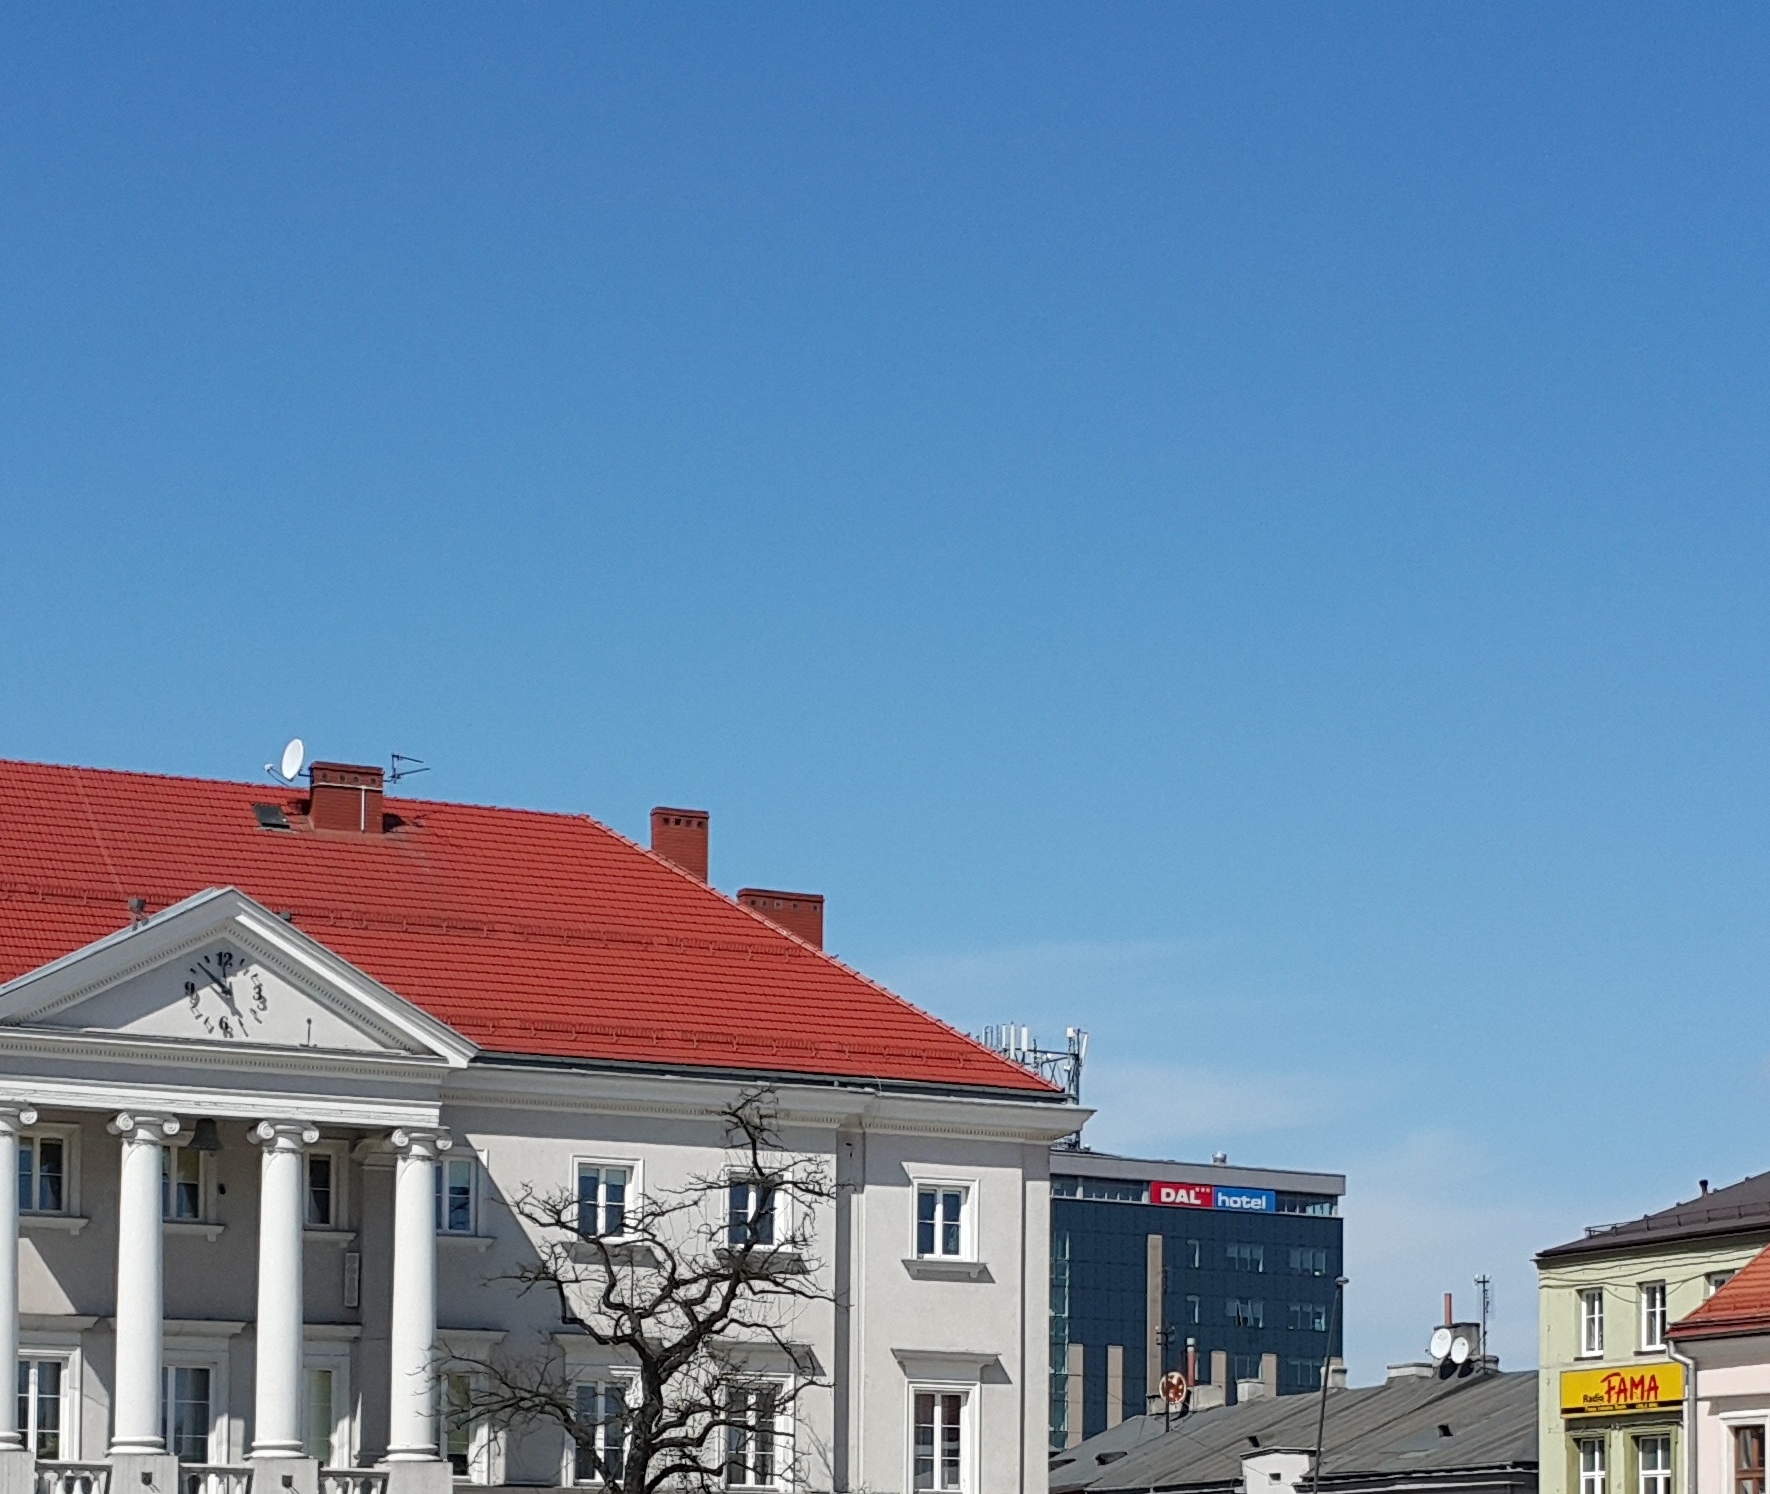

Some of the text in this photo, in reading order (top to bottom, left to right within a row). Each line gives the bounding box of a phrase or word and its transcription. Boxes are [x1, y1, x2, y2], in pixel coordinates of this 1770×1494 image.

[216, 952, 233, 967] 12
[185, 981, 195, 995] 9
[253, 986, 262, 1000] 3
[219, 1016, 228, 1030] 6
[1160, 1187, 1266, 1209] DAL hotel
[1600, 1372, 1659, 1403] FAMA
